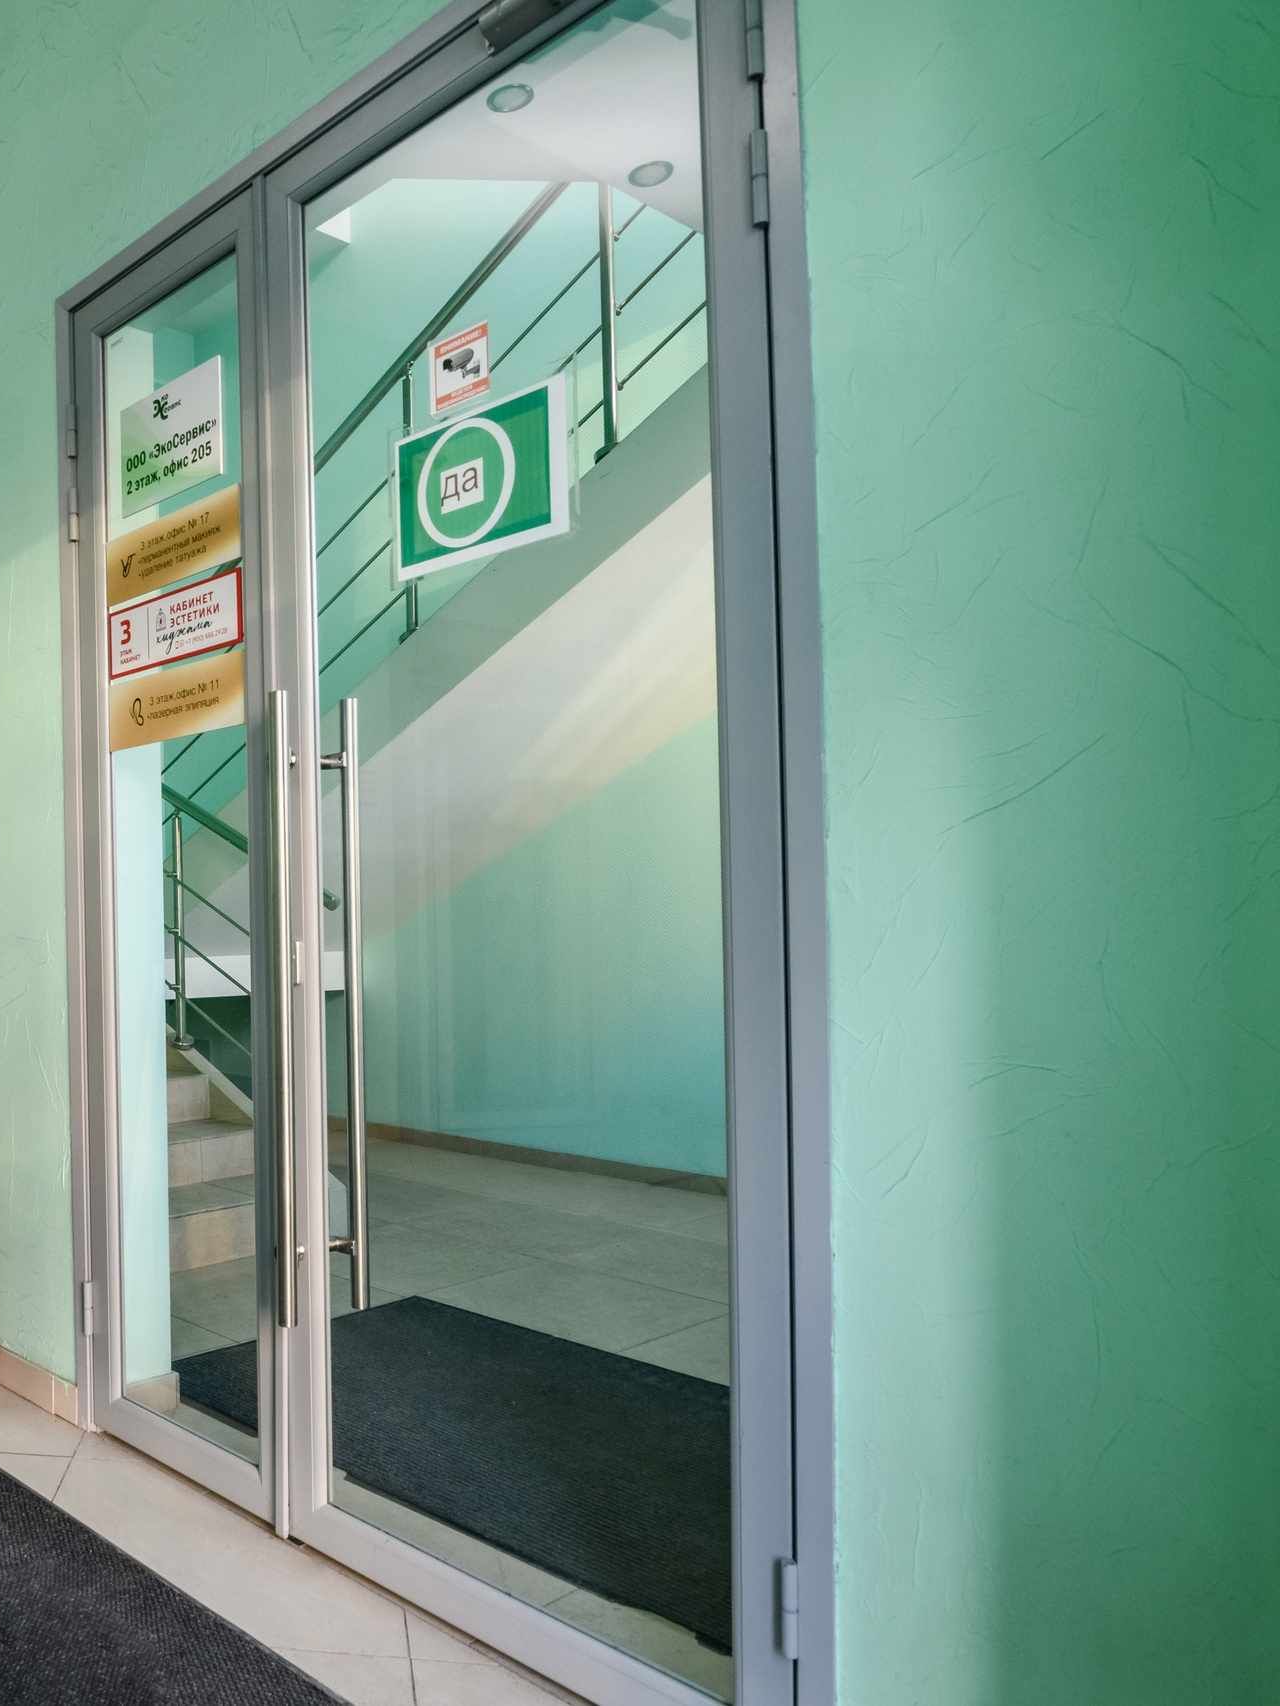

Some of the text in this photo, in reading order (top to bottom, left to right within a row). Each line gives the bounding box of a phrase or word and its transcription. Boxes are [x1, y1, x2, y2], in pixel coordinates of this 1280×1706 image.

[440, 329, 482, 354] ВНИМАНИЕ!
[126, 418, 217, 473] ООО «ЭкоСервис»
[126, 441, 212, 496] 2 этаж, офис 205
[441, 466, 479, 507] да
[140, 541, 145, 551] 3
[200, 511, 209, 525] 17
[192, 525, 222, 543] макияж
[141, 545, 207, 580] удаление татуажа
[169, 591, 214, 615] КАБИНЕТ
[170, 602, 220, 628] ЭСТЕТИКИ
[120, 619, 132, 645] 3
[149, 696, 154, 707] 3
[210, 678, 219, 691] 11
[150, 696, 220, 720] лазерная эпиляция
